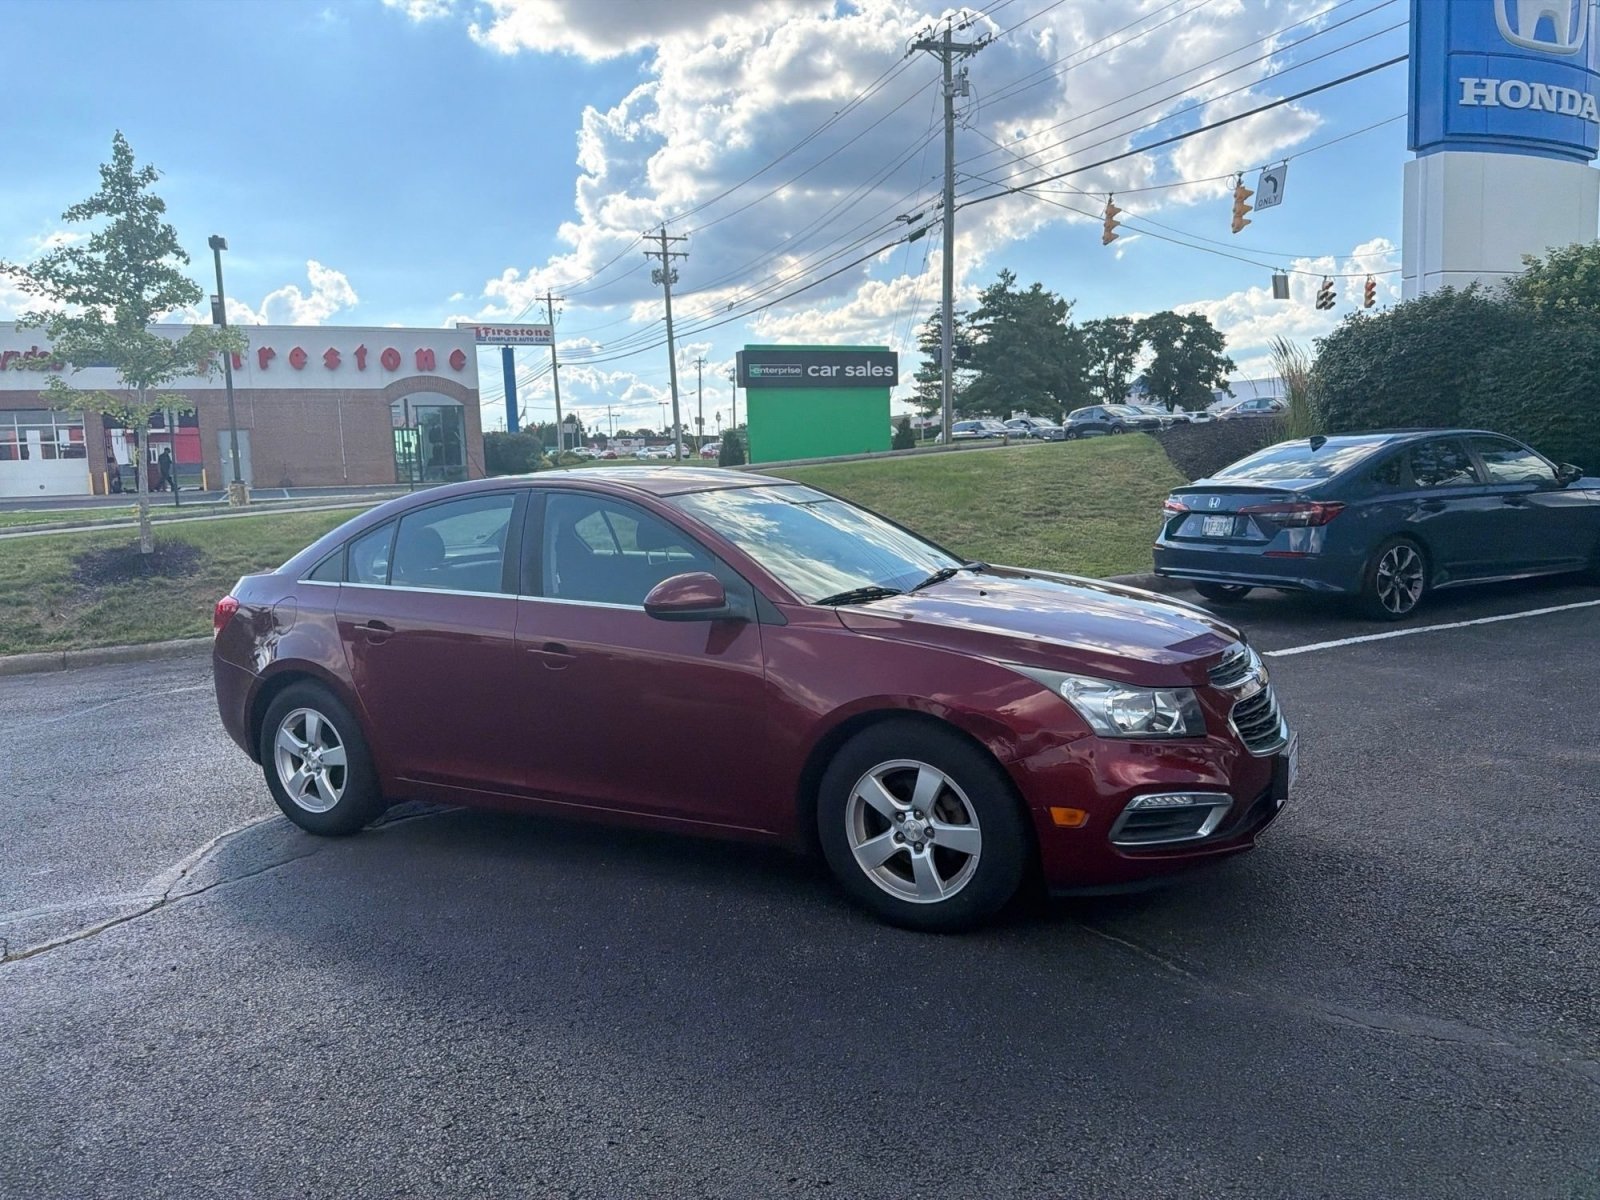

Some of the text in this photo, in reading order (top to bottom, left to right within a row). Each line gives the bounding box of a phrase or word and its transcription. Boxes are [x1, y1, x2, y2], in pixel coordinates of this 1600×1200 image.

[1459, 77, 1600, 123] HONDA
[1258, 195, 1278, 207] ONLY
[482, 327, 551, 336] Firestone
[751, 361, 894, 377] enterprise car sales
